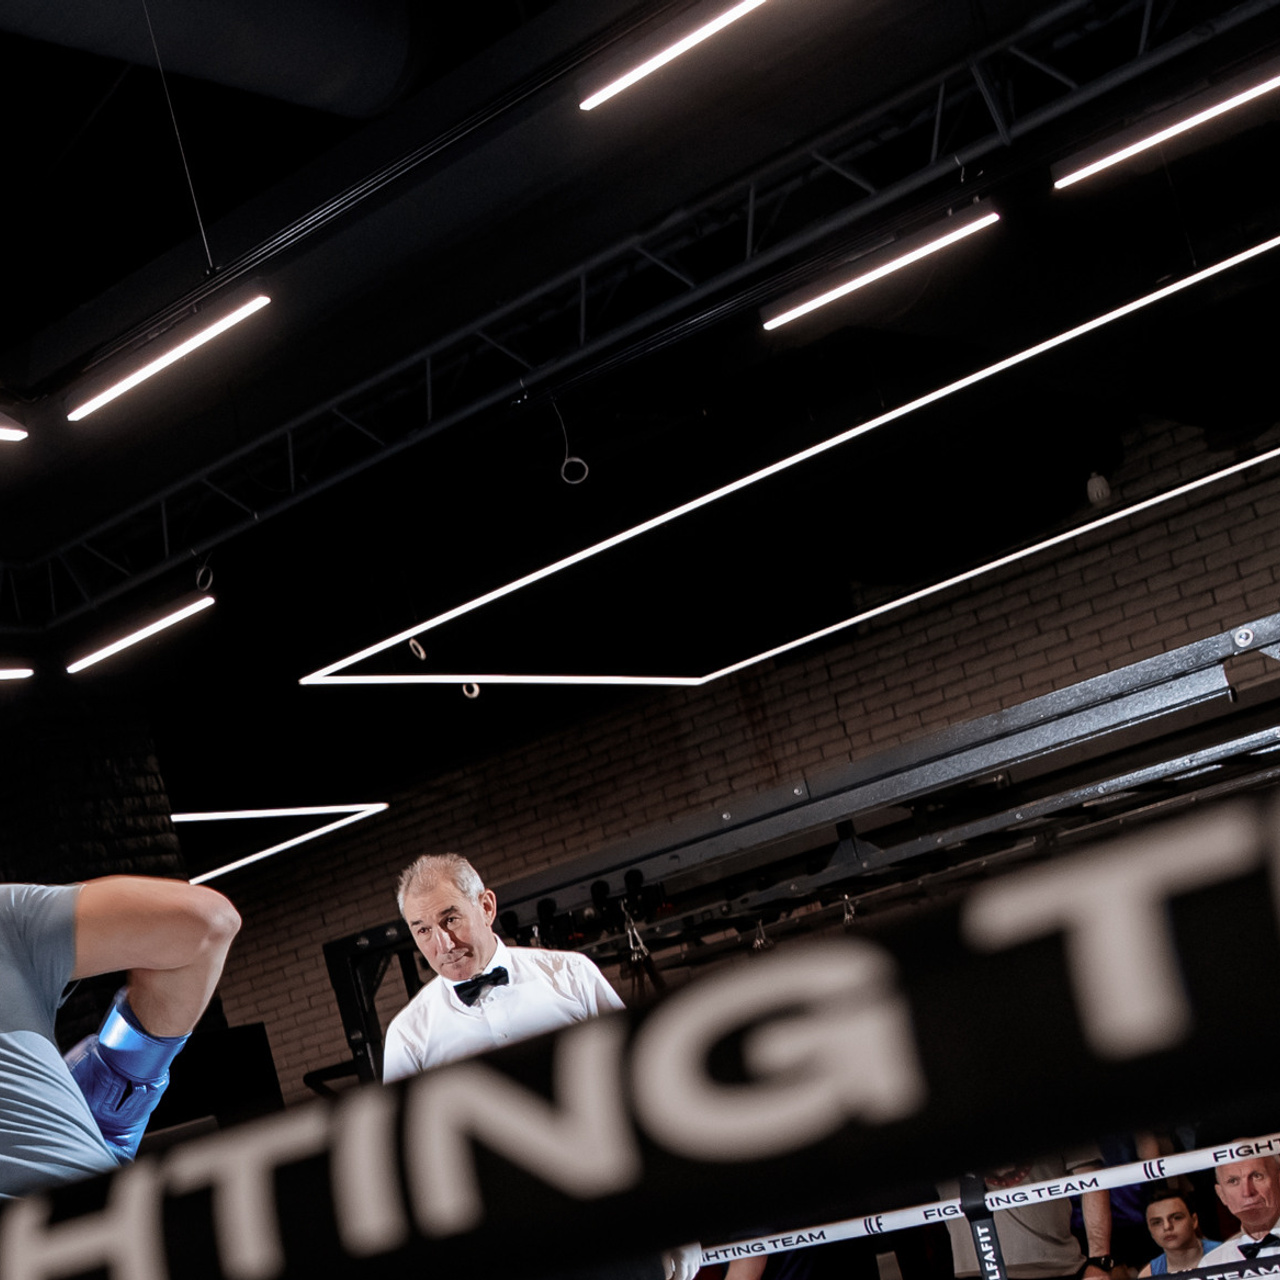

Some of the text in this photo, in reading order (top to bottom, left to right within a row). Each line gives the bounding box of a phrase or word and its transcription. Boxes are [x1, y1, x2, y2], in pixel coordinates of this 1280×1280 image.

[960, 797, 1280, 1062] T
[1031, 1177, 1100, 1199] TEAM
[702, 1230, 826, 1263] HTING TEAM
